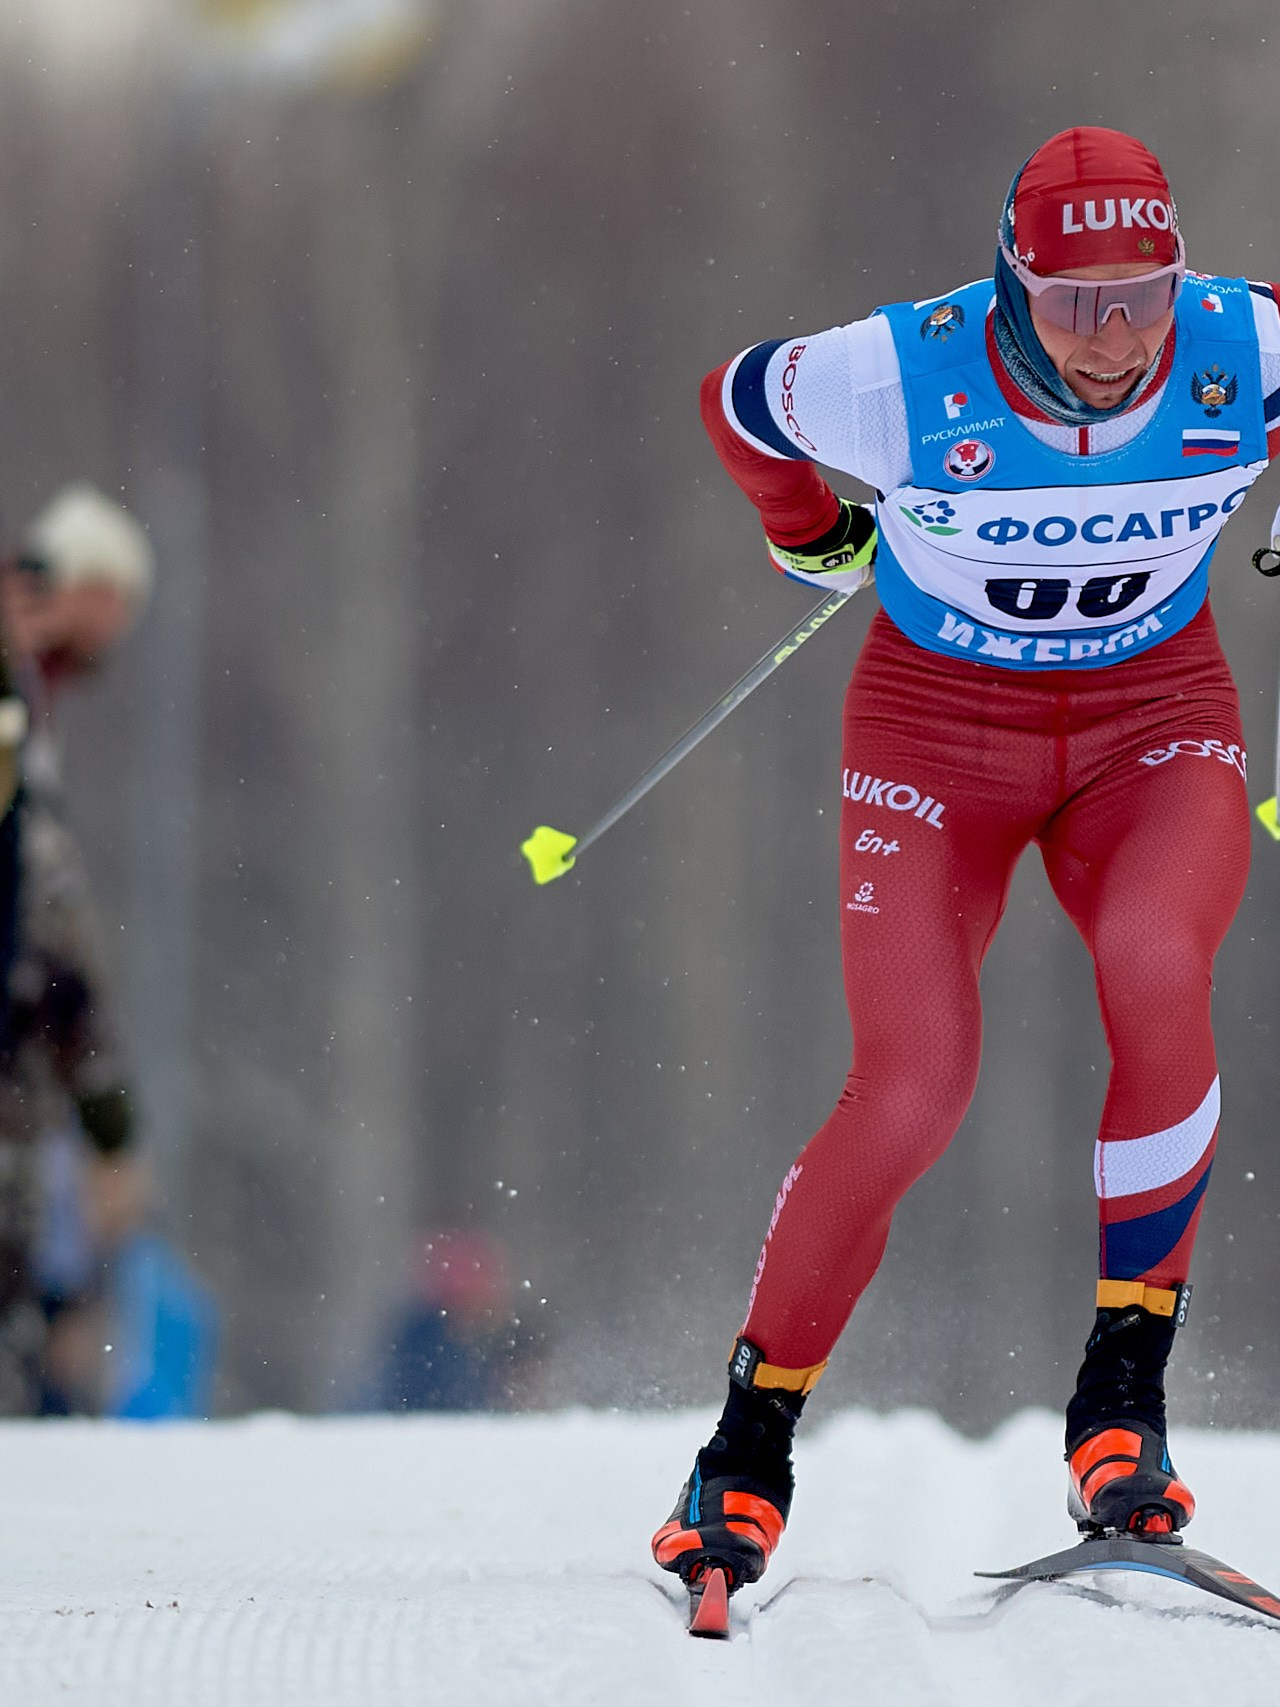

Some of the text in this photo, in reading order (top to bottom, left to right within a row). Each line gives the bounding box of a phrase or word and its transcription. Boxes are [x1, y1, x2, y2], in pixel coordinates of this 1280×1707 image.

[782, 344, 817, 452] BOSCO
[922, 417, 1006, 445] РУСКЛИМАТ
[843, 768, 946, 830] LUKOIL
[855, 829, 901, 856] En+
[735, 1345, 751, 1378] 260
